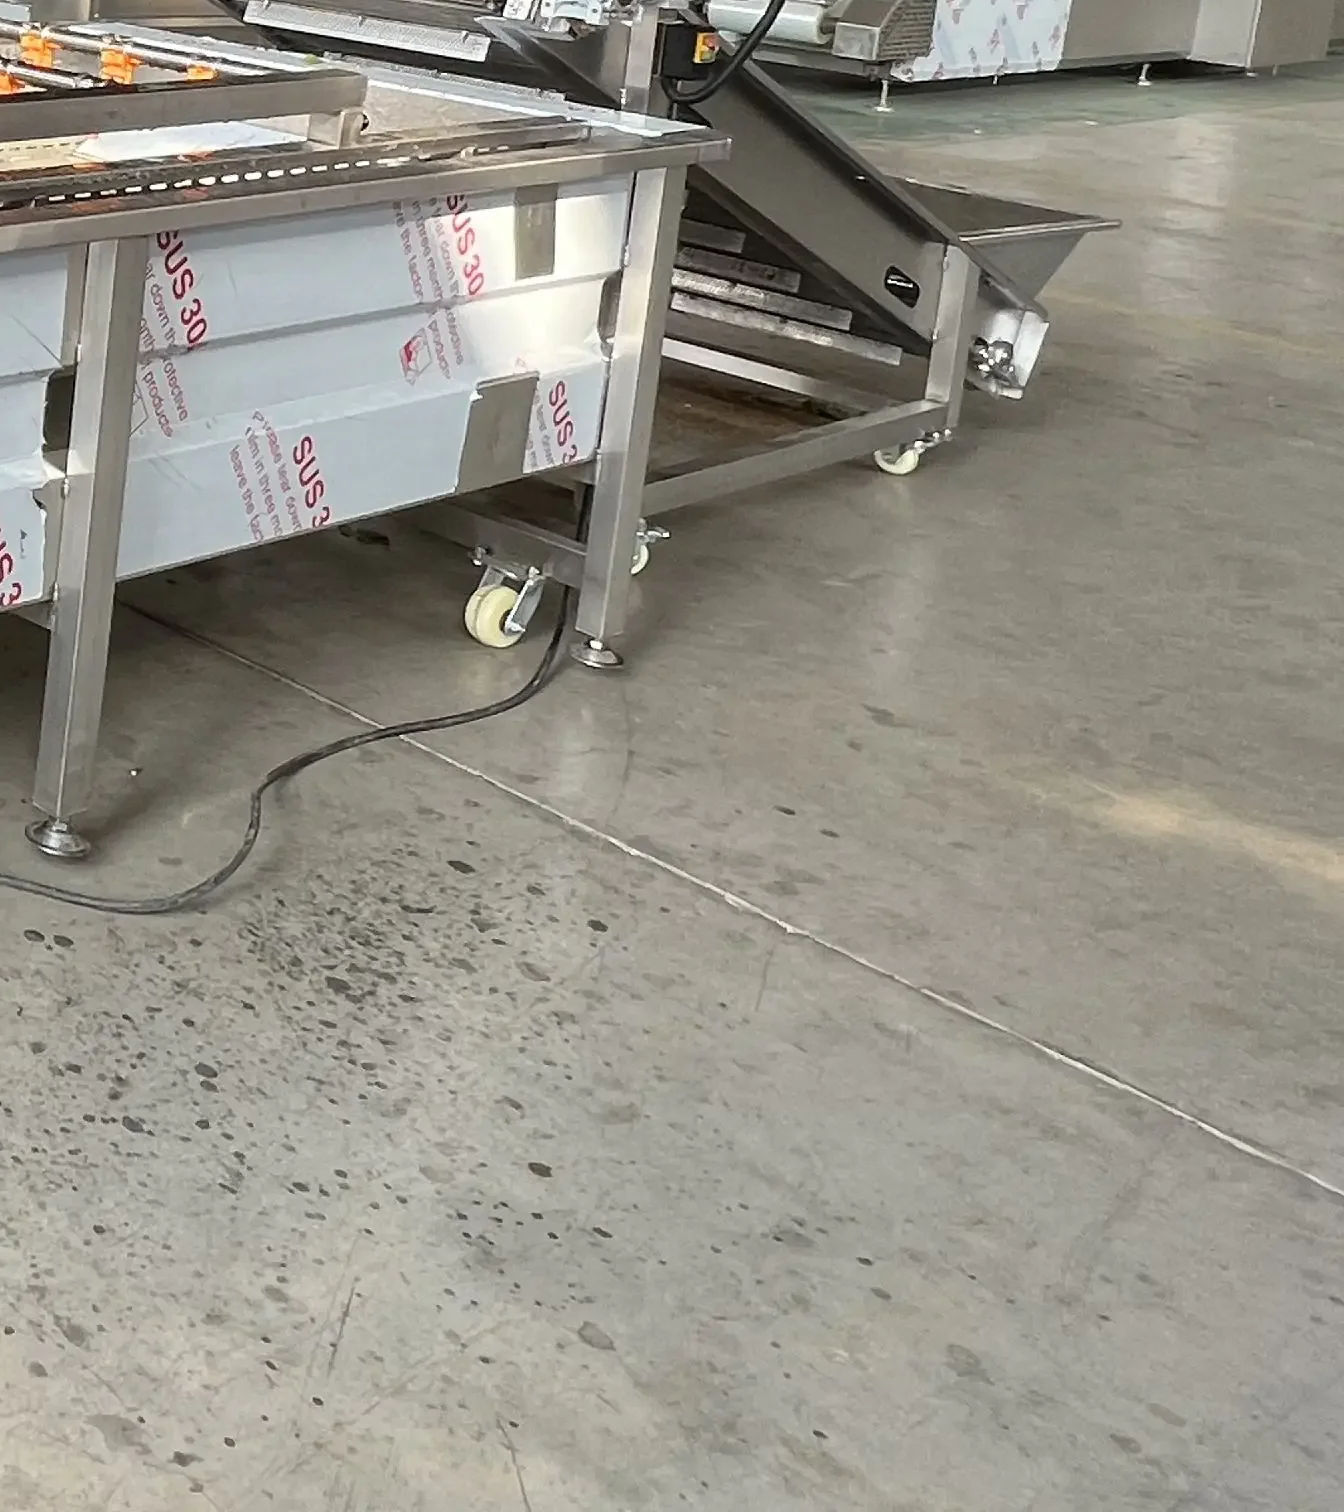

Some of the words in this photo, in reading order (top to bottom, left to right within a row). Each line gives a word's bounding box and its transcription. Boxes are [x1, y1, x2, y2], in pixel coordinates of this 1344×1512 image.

[549, 380, 574, 447] SUS
[242, 488, 255, 515] the
[293, 436, 325, 508] SUS
